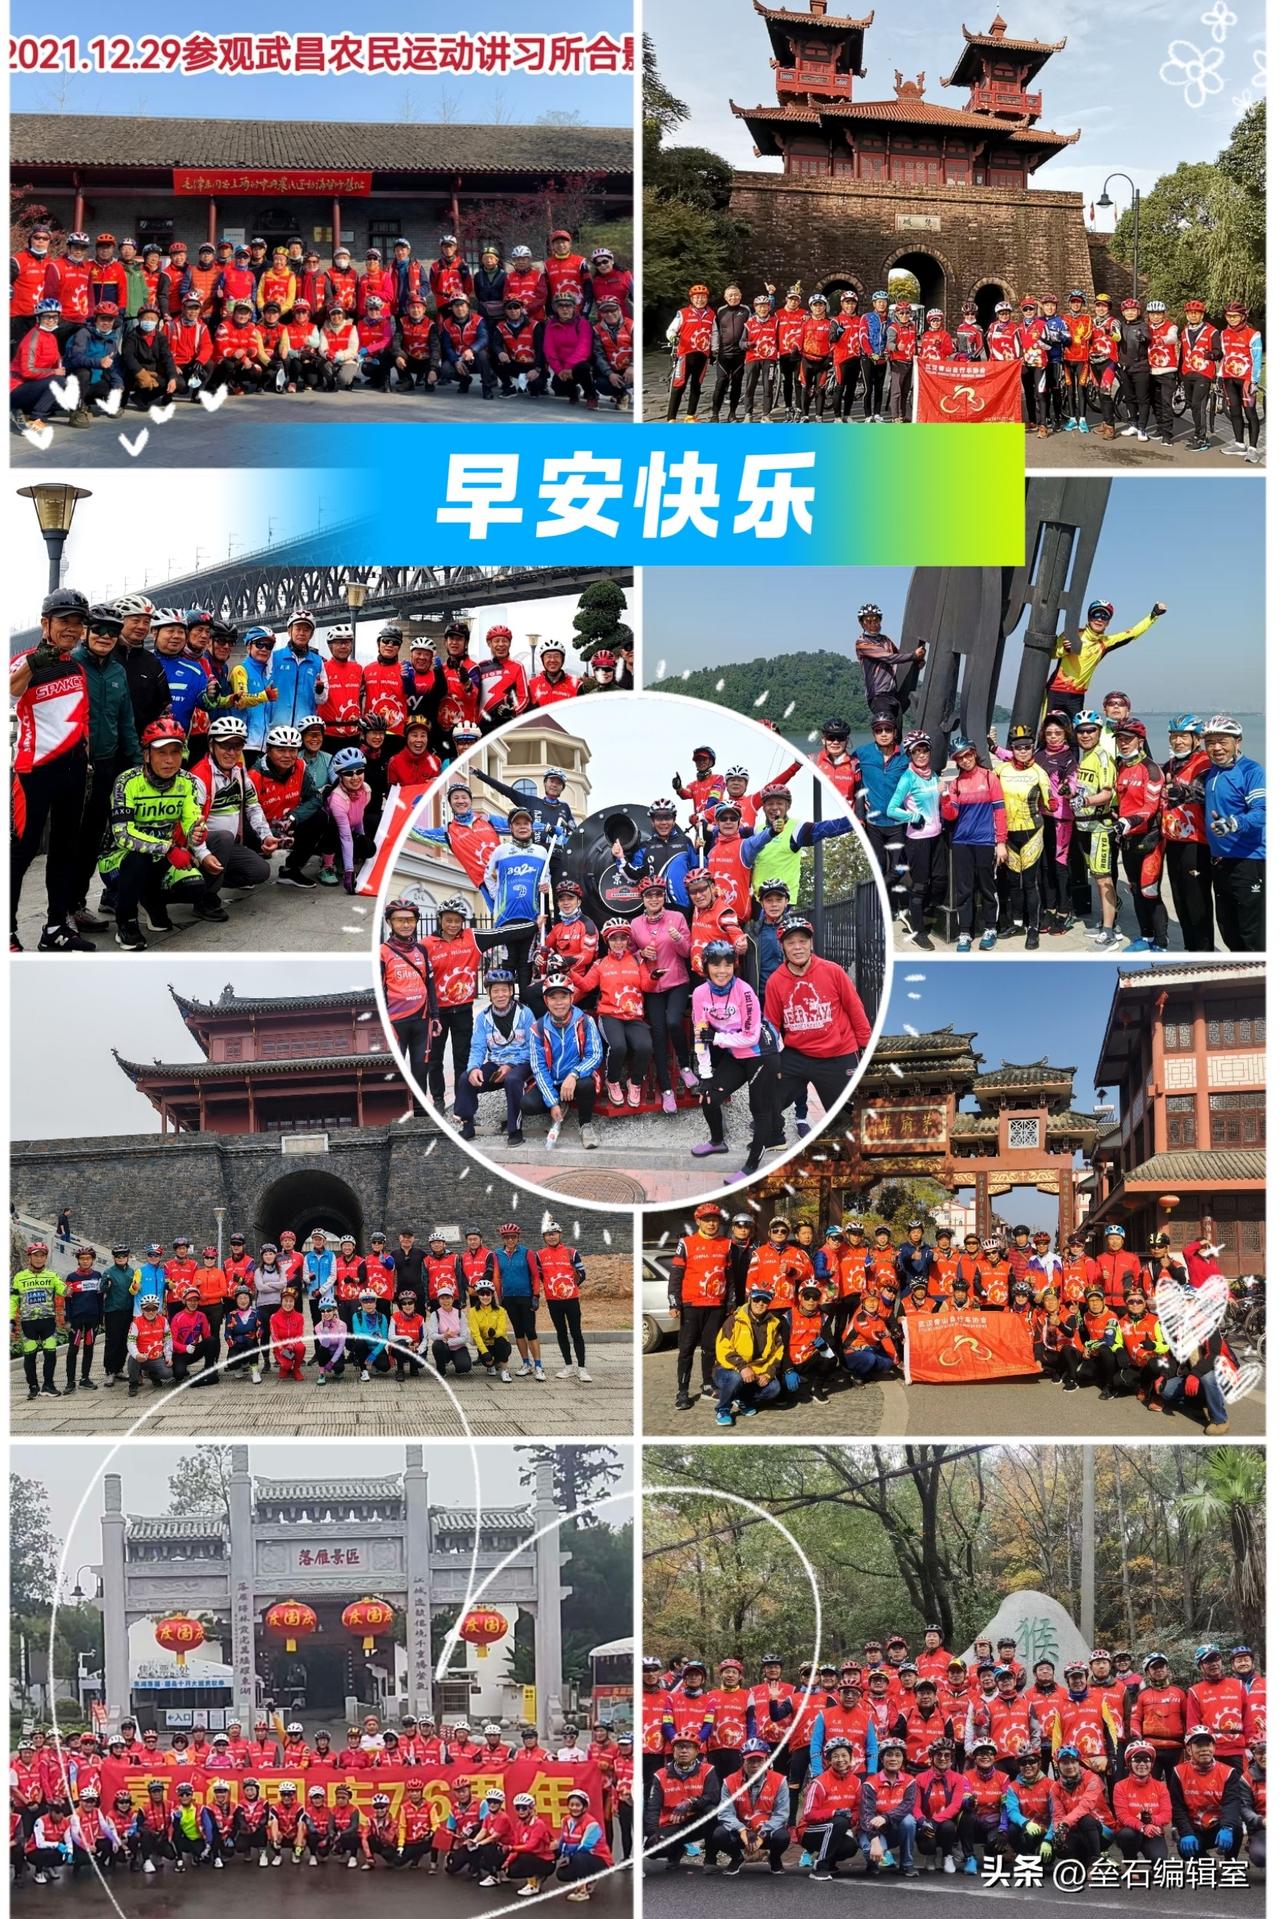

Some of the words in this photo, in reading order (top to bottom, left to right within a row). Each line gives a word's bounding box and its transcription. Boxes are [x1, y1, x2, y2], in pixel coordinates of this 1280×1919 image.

[612, 872, 622, 885] 京
[21, 1279, 52, 1288] Tinkoff
[1014, 1616, 1059, 1662] 猴
[175, 1713, 191, 1721] 入口
